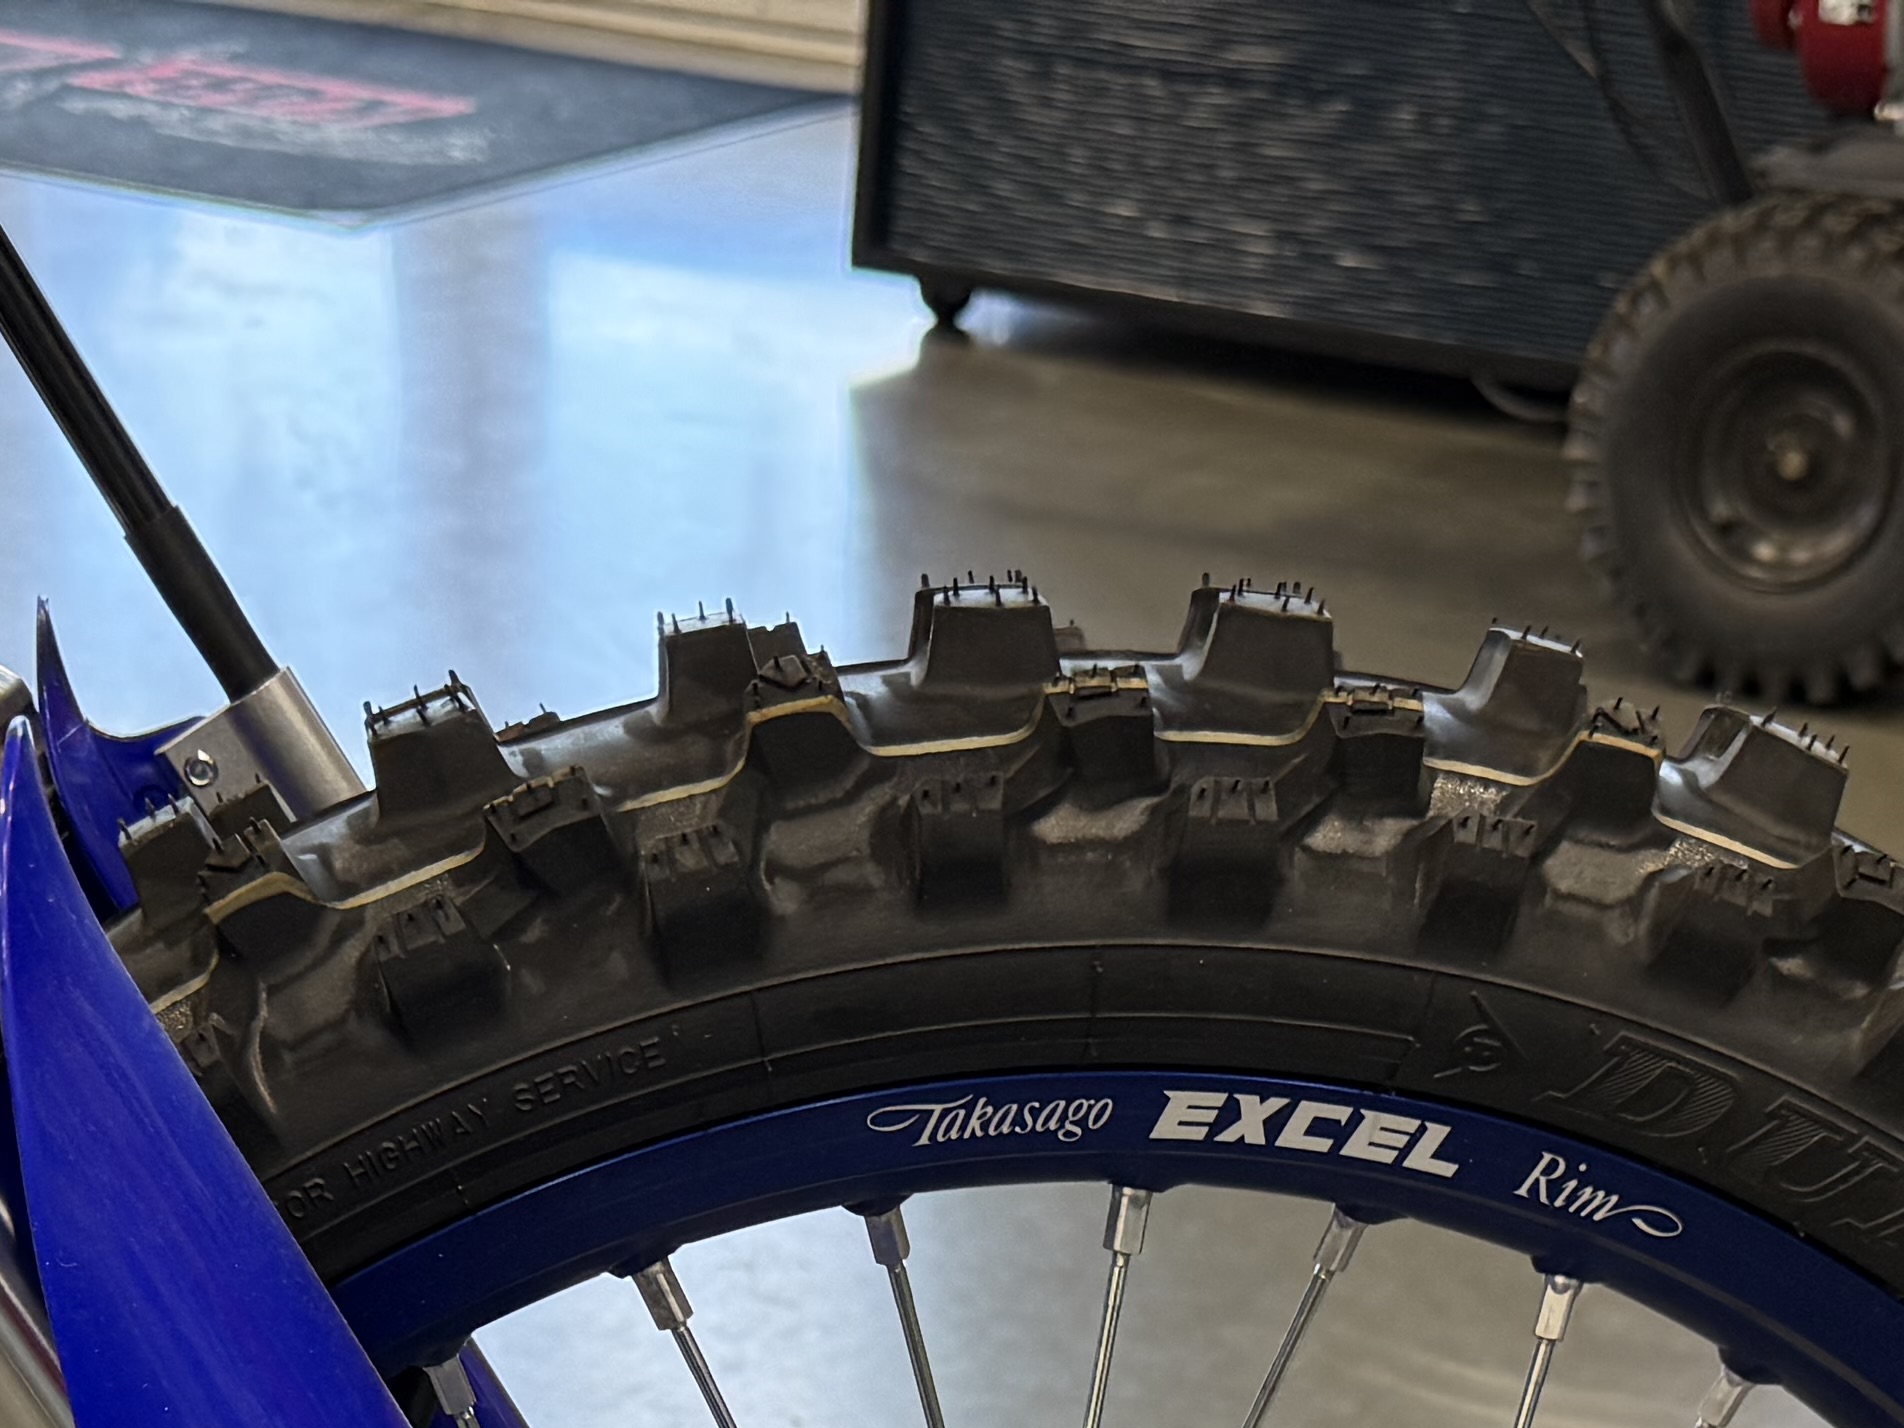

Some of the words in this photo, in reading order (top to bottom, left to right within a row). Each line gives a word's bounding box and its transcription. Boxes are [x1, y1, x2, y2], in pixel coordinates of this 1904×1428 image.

[343, 1096, 491, 1187] HIGHWAY
[512, 1034, 668, 1112] SERVICE
[866, 1094, 1113, 1148] Takasago
[1149, 1089, 1459, 1179] EXCEL
[1514, 1151, 1683, 1238] Rim
